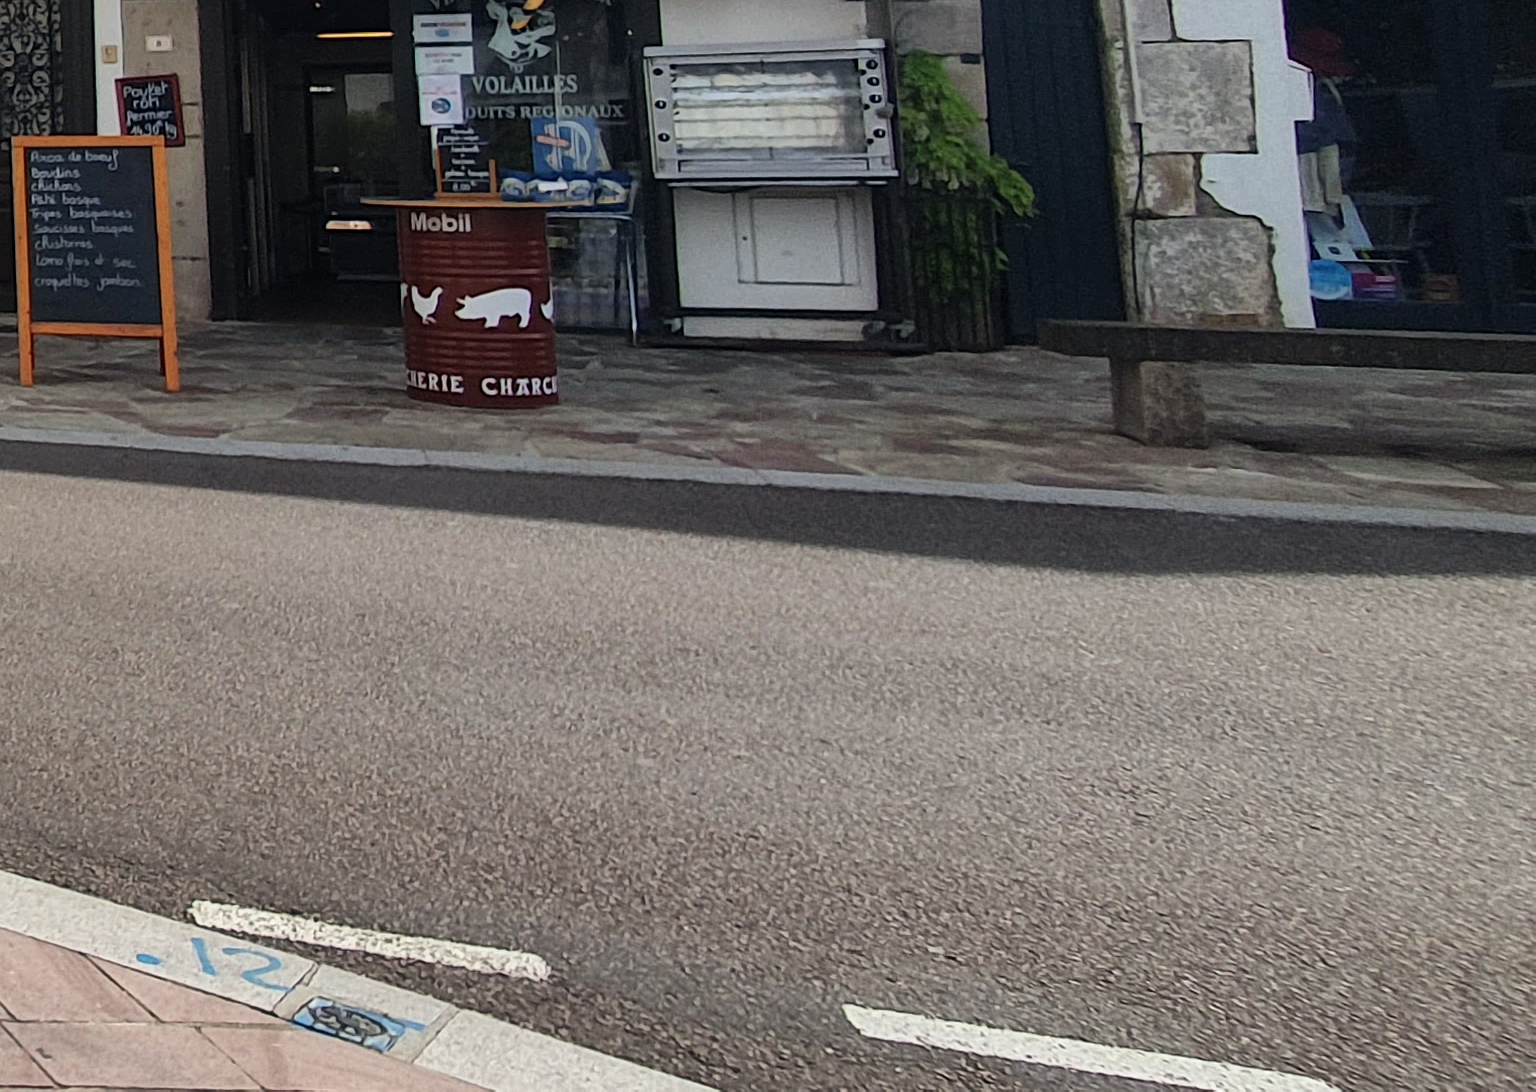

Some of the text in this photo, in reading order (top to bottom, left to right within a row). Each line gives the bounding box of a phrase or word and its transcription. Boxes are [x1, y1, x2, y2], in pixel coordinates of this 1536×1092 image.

[471, 74, 578, 95] VOLAILLES
[466, 104, 625, 120] DUITS REGONAUX
[68, 151, 82, 162] de
[31, 166, 81, 179] Boudins
[410, 212, 472, 233] Mobil
